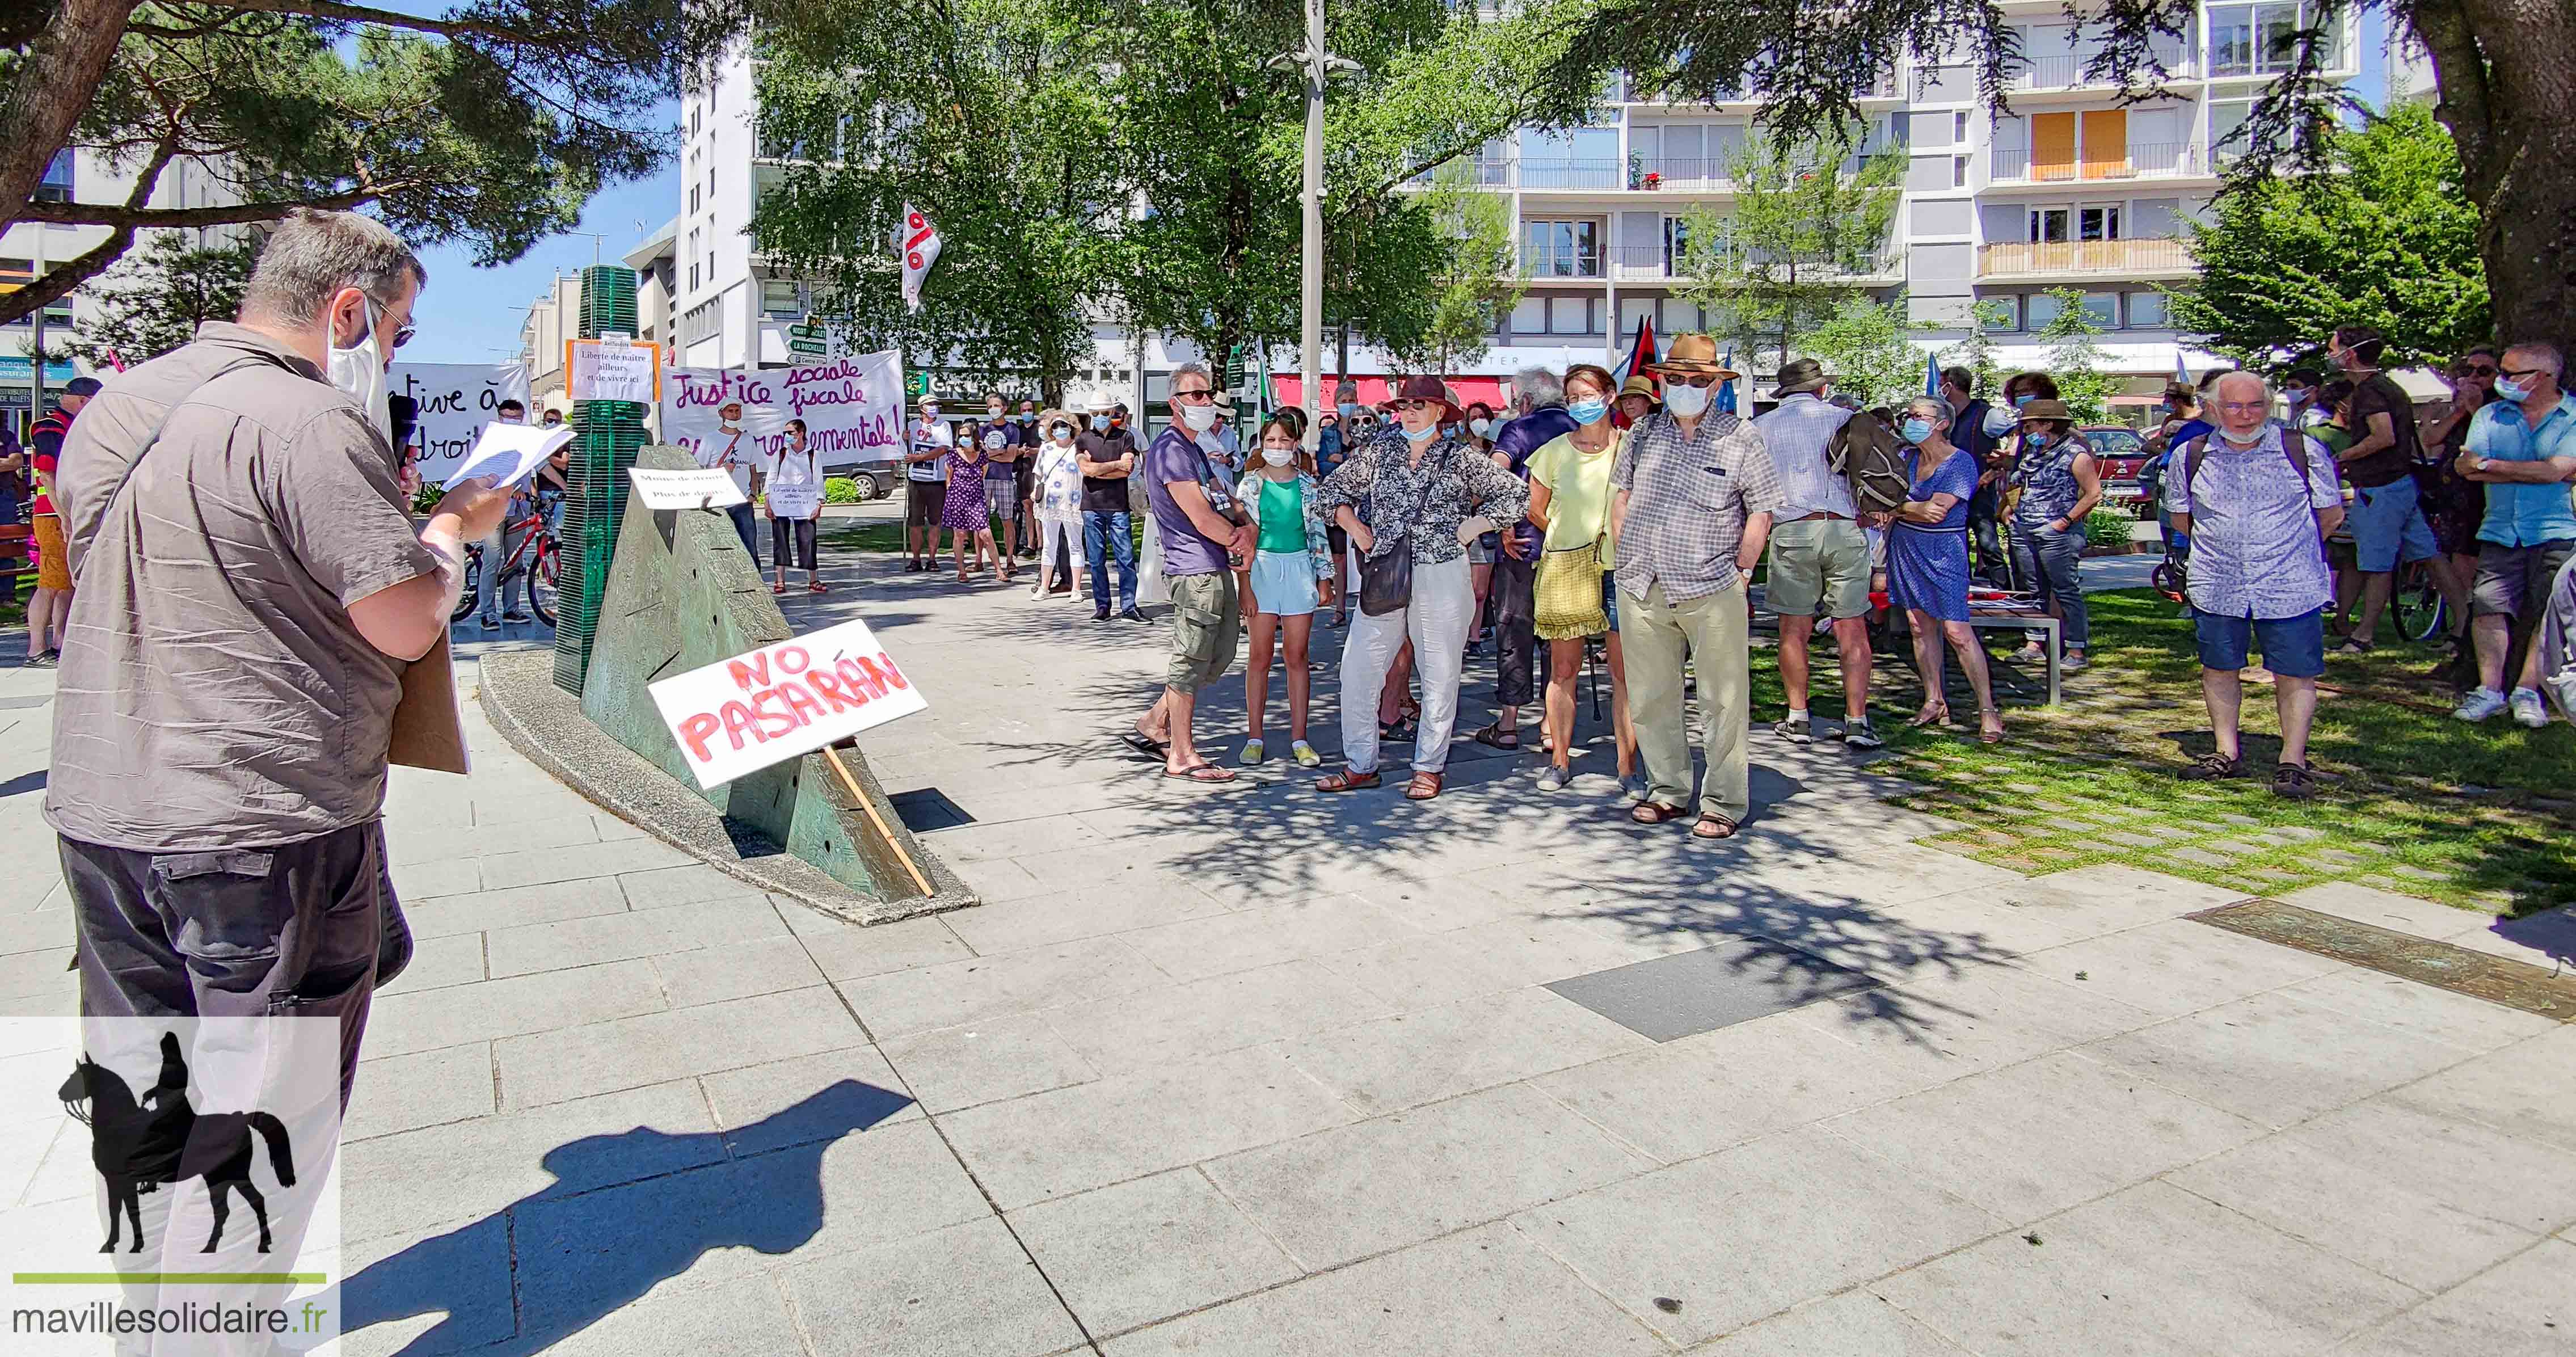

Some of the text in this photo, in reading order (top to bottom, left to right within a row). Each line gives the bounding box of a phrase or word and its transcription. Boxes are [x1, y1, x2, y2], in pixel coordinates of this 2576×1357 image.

[792, 327, 807, 335] NIORT
[581, 351, 609, 360] Liberté
[622, 353, 646, 362] naître
[801, 343, 825, 352] ROCHELLE
[597, 363, 628, 372] ailleurs
[672, 359, 862, 408] Justice sociale
[480, 380, 499, 413] à
[788, 380, 867, 416] fiscale
[727, 646, 810, 689] NO
